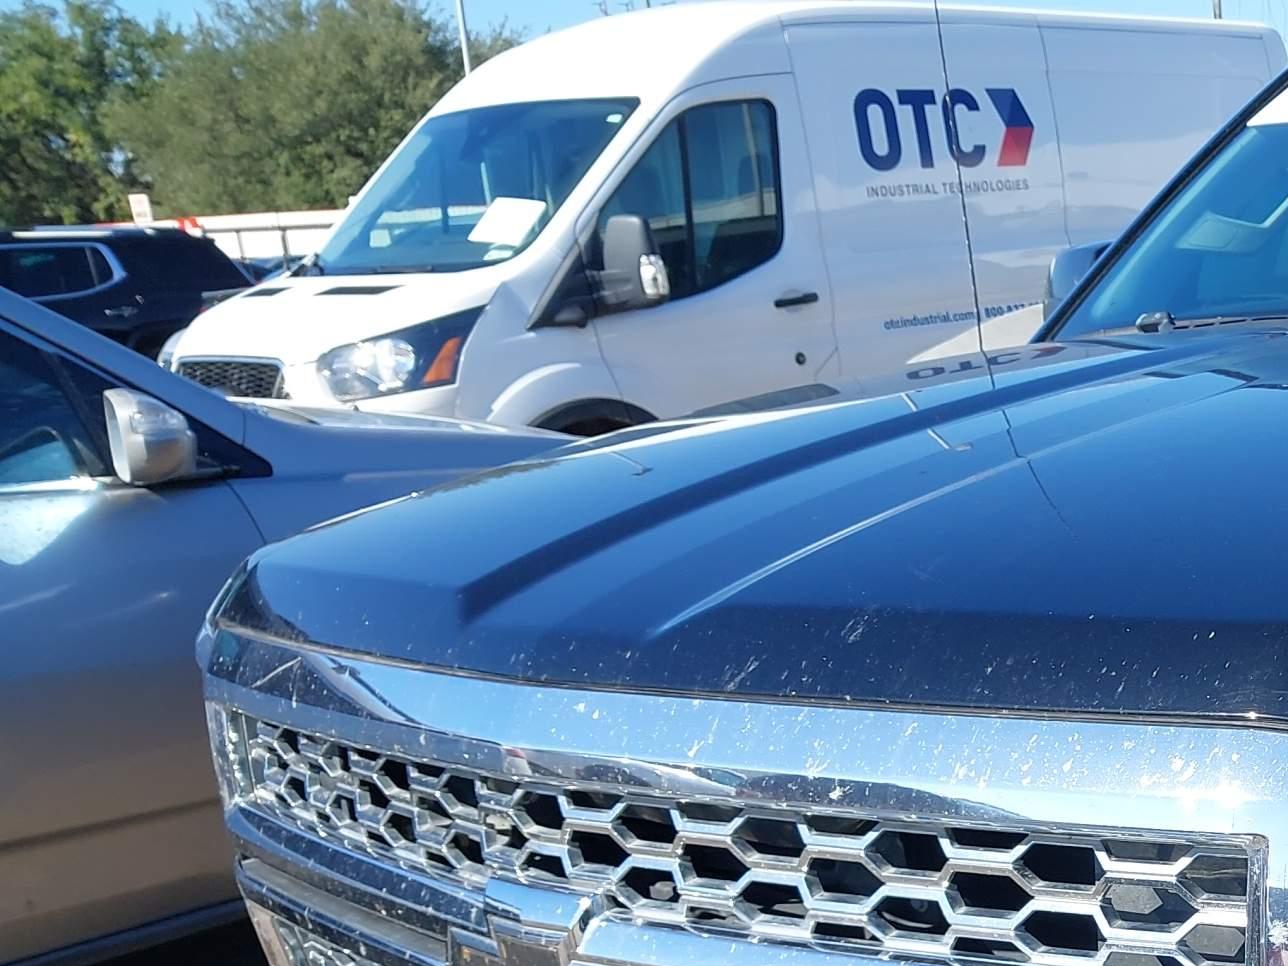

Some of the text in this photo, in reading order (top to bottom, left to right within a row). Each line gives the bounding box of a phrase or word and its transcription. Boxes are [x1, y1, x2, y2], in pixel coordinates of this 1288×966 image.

[853, 88, 986, 171] OTC
[866, 178, 1029, 198] INDUSTRIAL TECHNOLOGIES
[884, 311, 976, 330] otcindustrial.com
